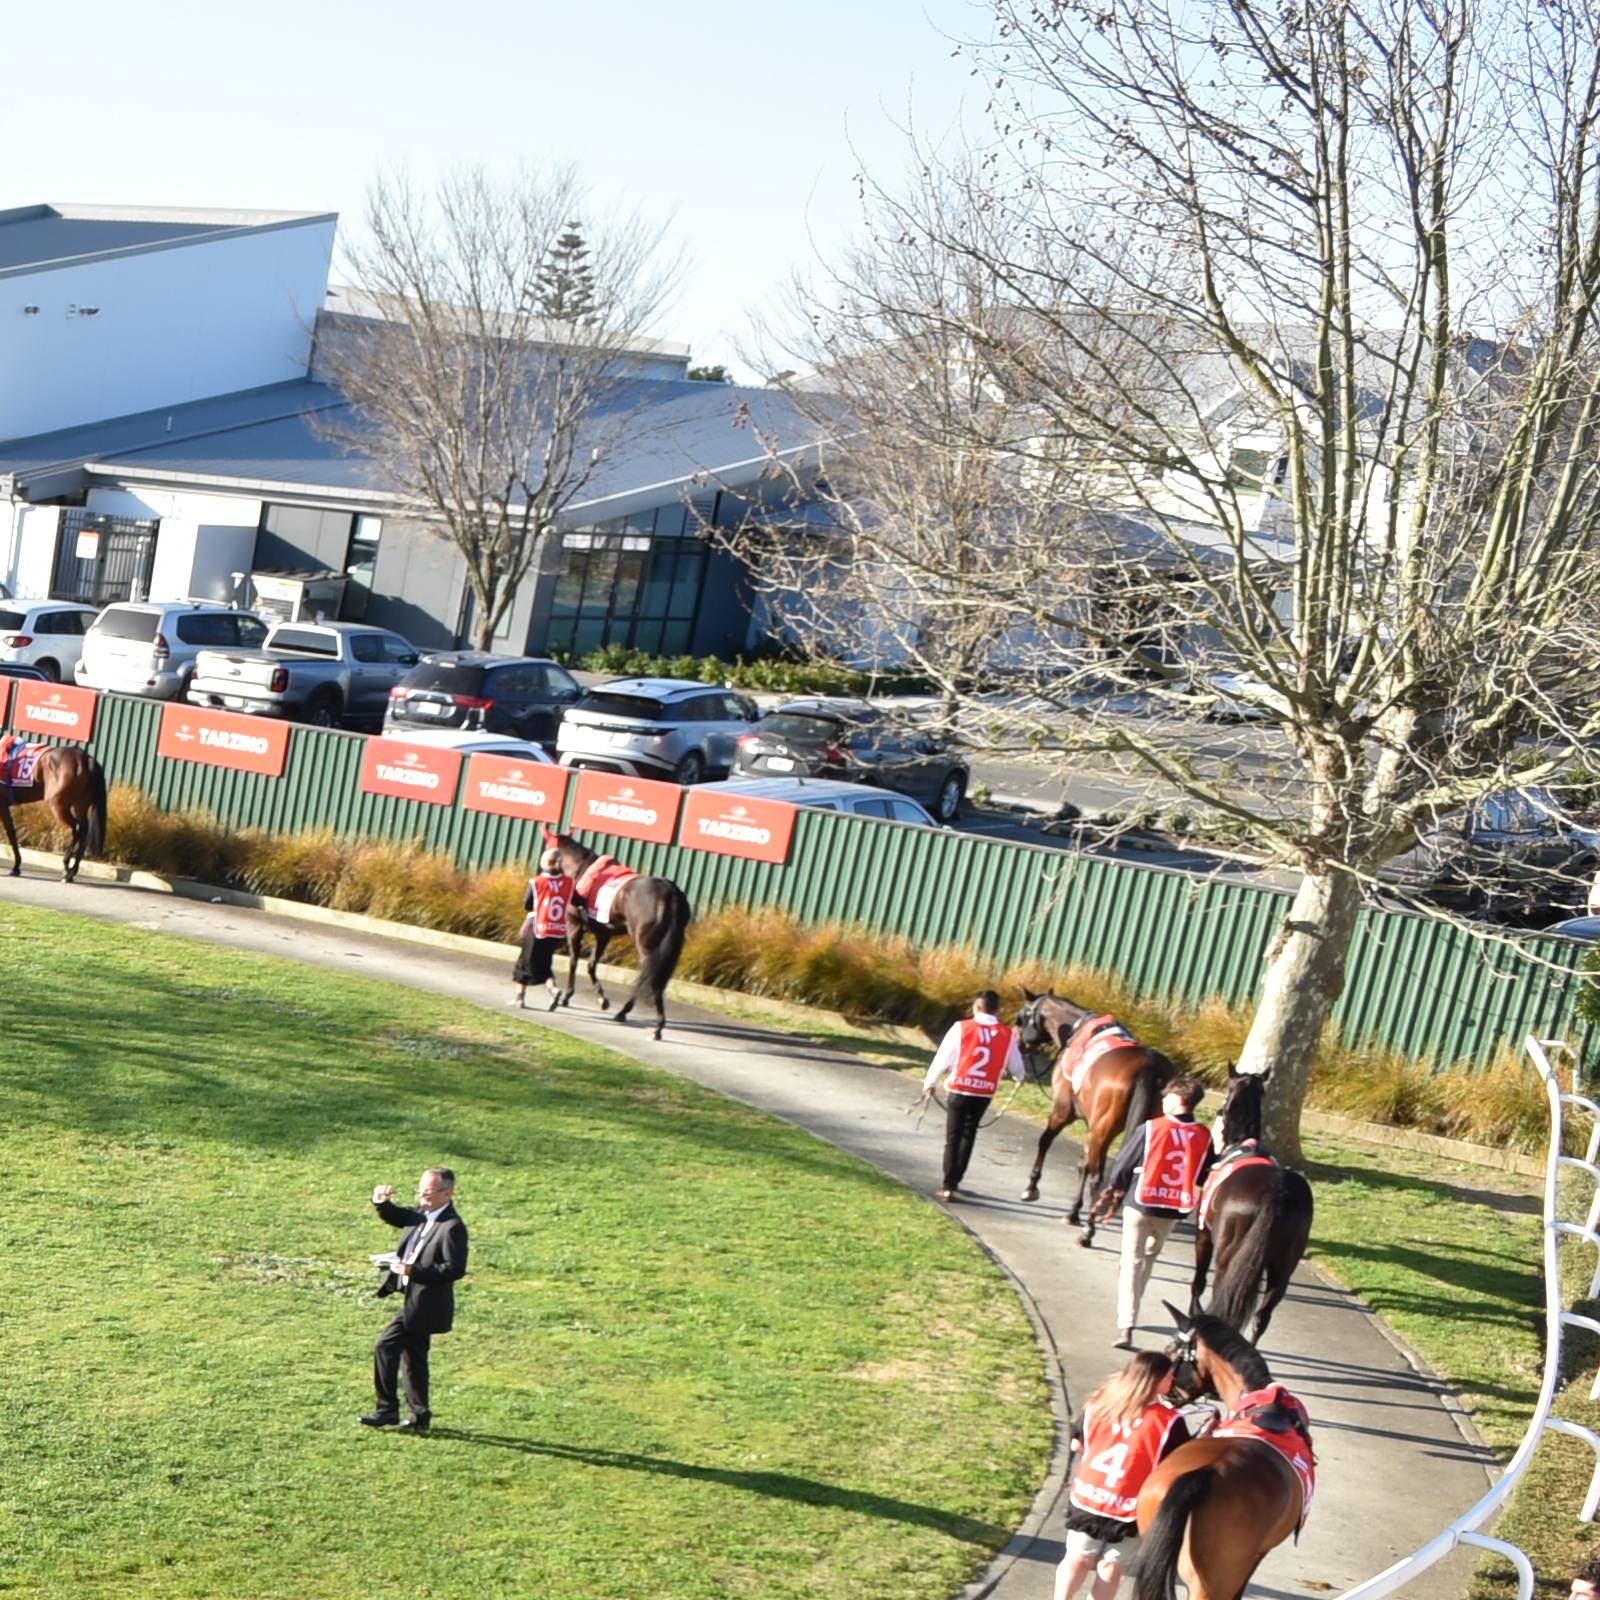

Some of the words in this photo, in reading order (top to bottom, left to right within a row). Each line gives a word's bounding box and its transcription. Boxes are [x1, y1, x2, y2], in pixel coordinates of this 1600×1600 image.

[25, 704, 79, 726] TARZINO
[198, 727, 269, 755] TARZINO
[17, 758, 33, 779] 15
[376, 764, 439, 789] TARZINO
[479, 781, 546, 806] TARZINO
[588, 799, 657, 826] TARZINO
[698, 818, 771, 845] TARZINO
[970, 1046, 991, 1078] 2
[1161, 1150, 1186, 1187] 3
[1090, 1442, 1129, 1488] 4
